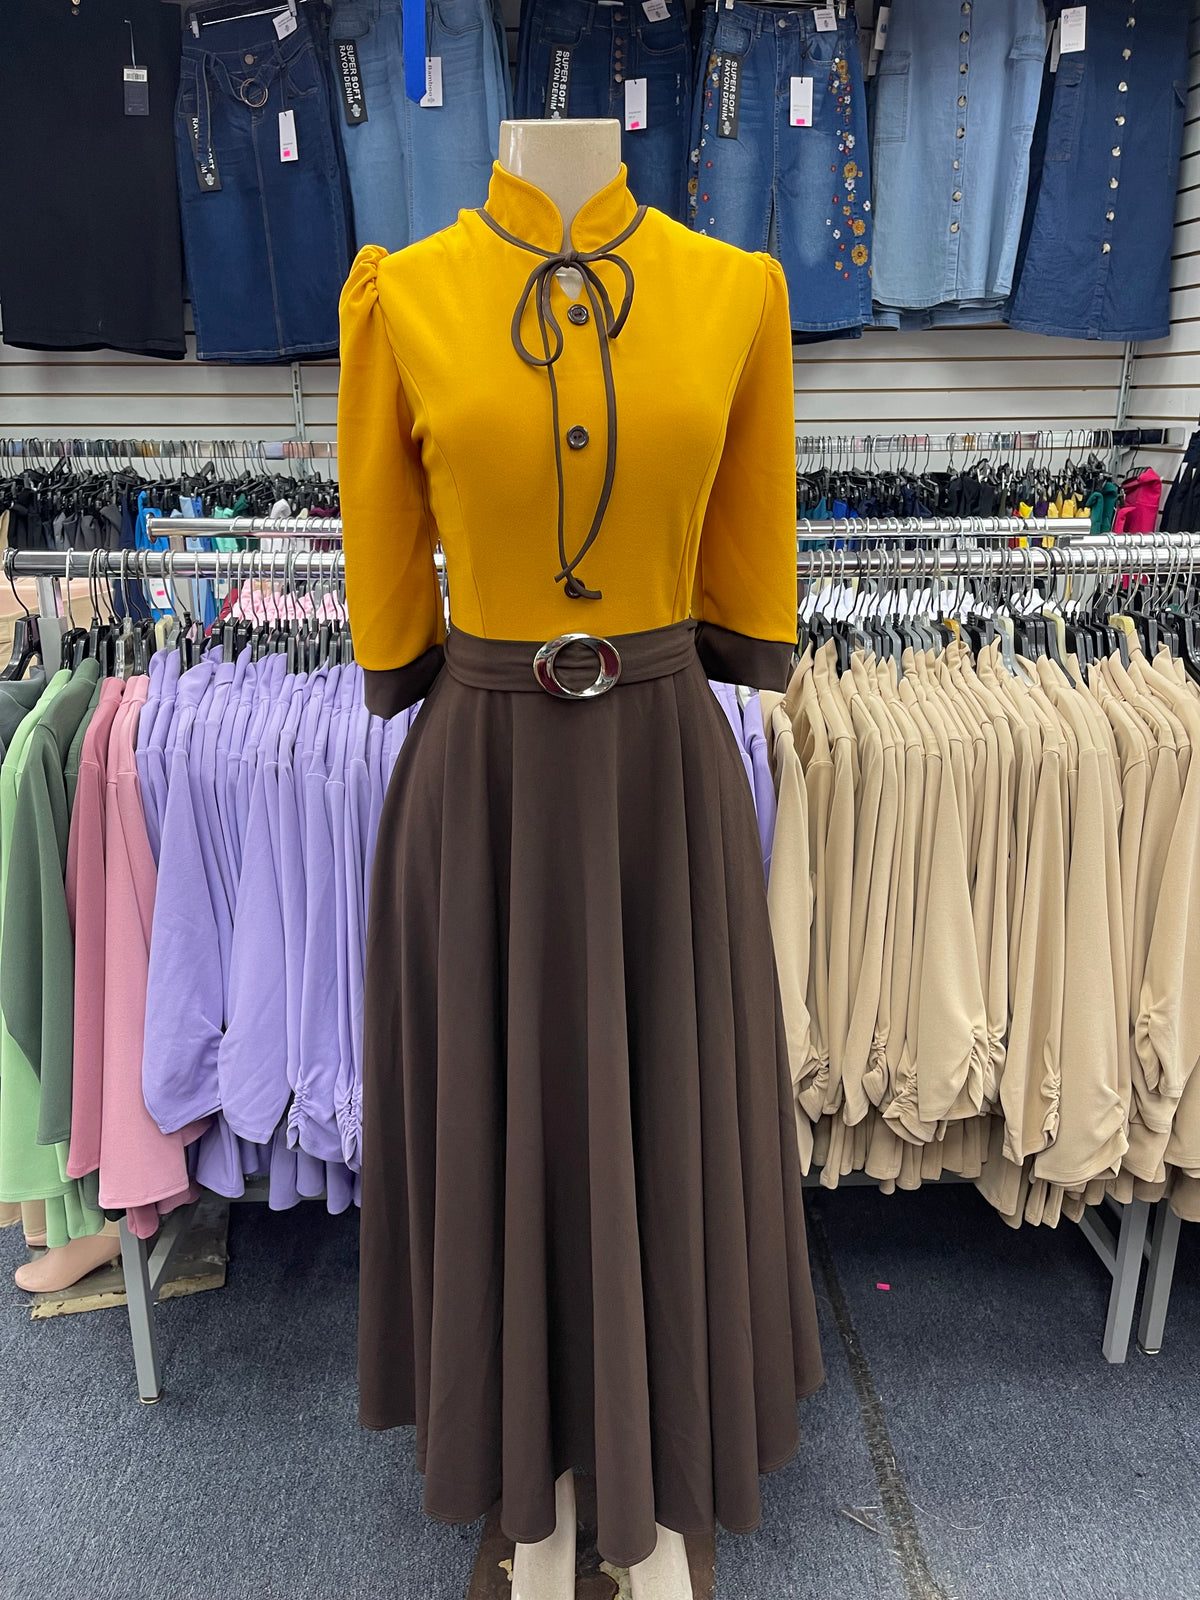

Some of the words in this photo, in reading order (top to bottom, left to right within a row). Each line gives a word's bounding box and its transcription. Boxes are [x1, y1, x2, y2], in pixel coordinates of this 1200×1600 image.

[339, 45, 349, 75] RAYON
[344, 76, 354, 104] DENIM
[346, 45, 357, 75] SUPER
[553, 50, 562, 81] RAYON
[560, 51, 570, 82] SUPER
[723, 59, 731, 91] RAYON
[351, 76, 361, 100] SOFT
[729, 60, 738, 92] SUPER
[550, 82, 559, 110] DENIM
[557, 83, 567, 109] SOFT
[721, 91, 729, 121] DENIM
[728, 93, 736, 118] SOFT
